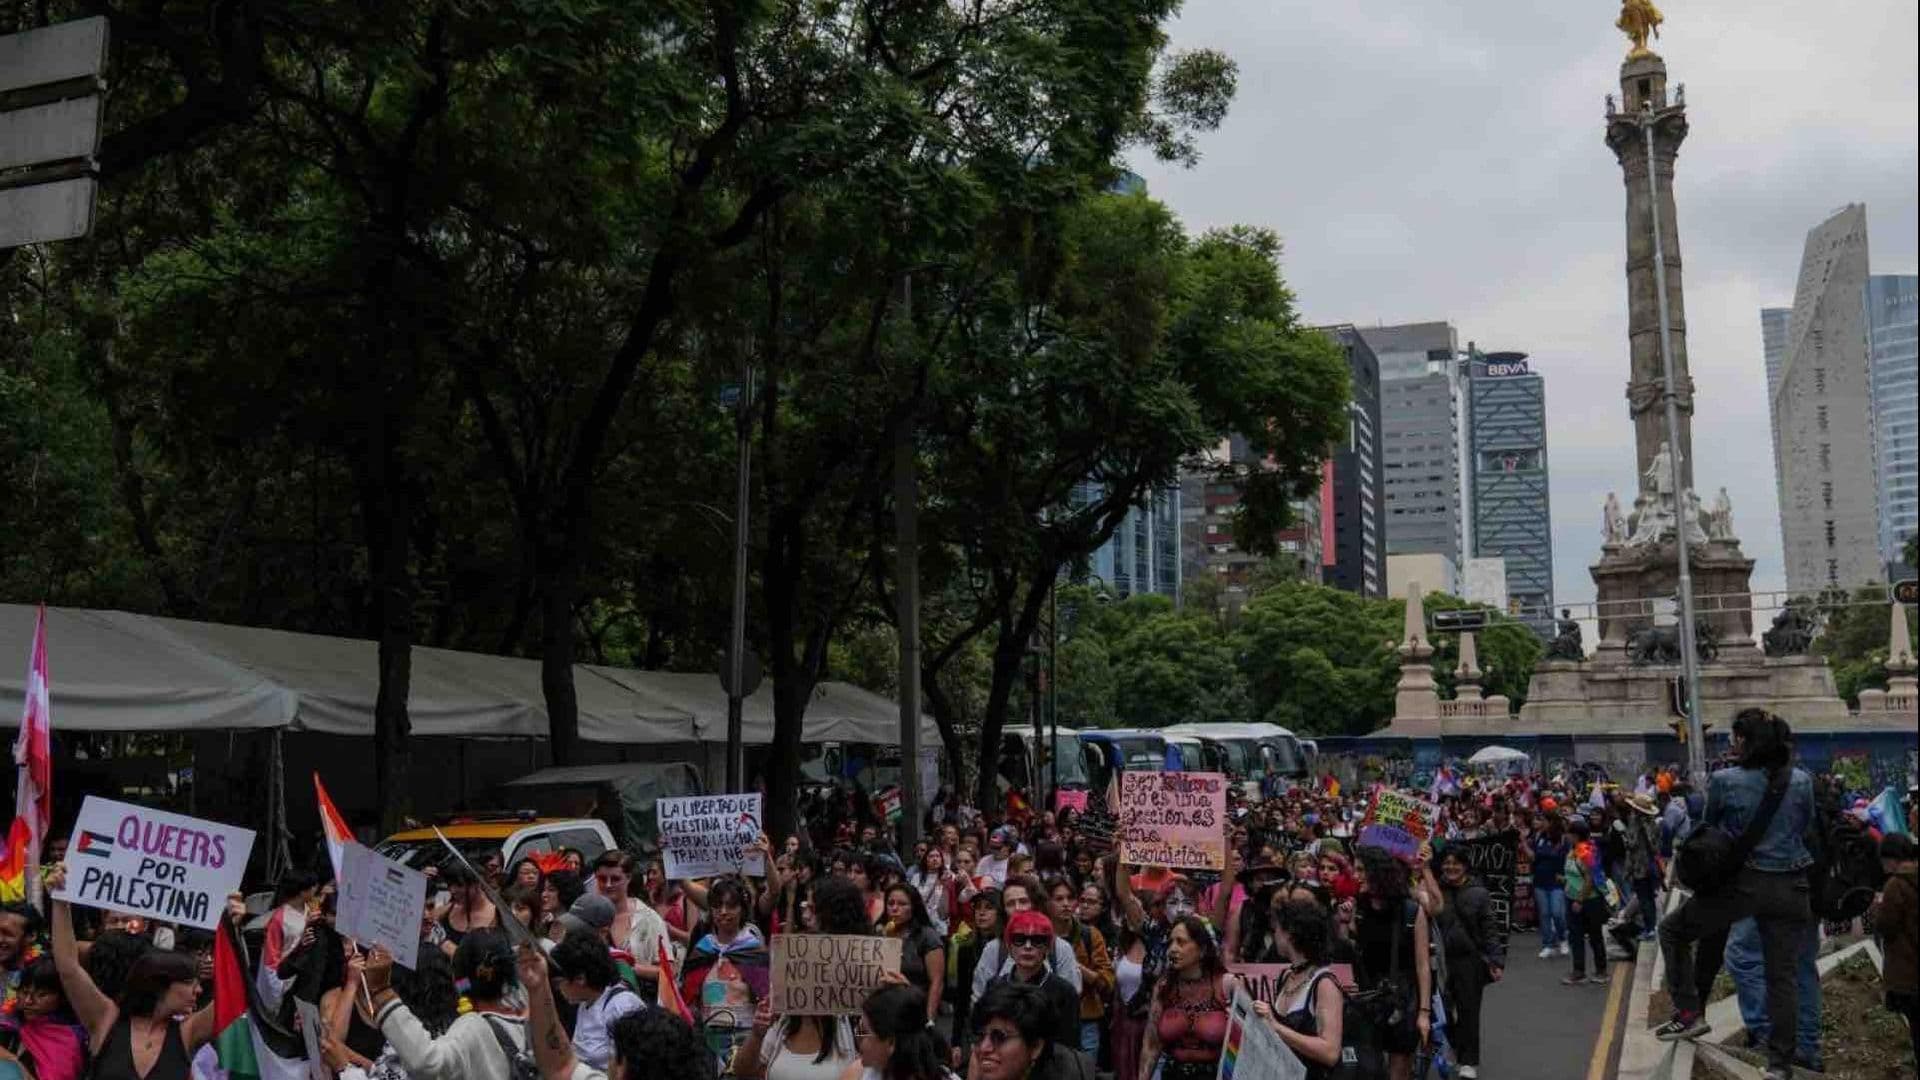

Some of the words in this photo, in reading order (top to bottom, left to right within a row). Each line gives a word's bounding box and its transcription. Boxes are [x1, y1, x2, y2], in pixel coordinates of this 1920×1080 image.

[1488, 361, 1526, 376] BBVA
[661, 801, 680, 818] LA
[683, 798, 737, 817] LIBERTAD
[739, 798, 756, 812] DE
[1123, 792, 1147, 806] no
[1151, 791, 1170, 806] es
[1175, 793, 1212, 807] una
[117, 814, 225, 869] QUEERS
[138, 857, 187, 884] POR
[78, 866, 210, 922] PALESTINA
[786, 935, 808, 959] LO
[819, 936, 884, 963] QUEER
[785, 959, 808, 981] NO
[812, 962, 831, 983] TE
[835, 962, 883, 987] QUITA
[786, 986, 807, 1009] LO
